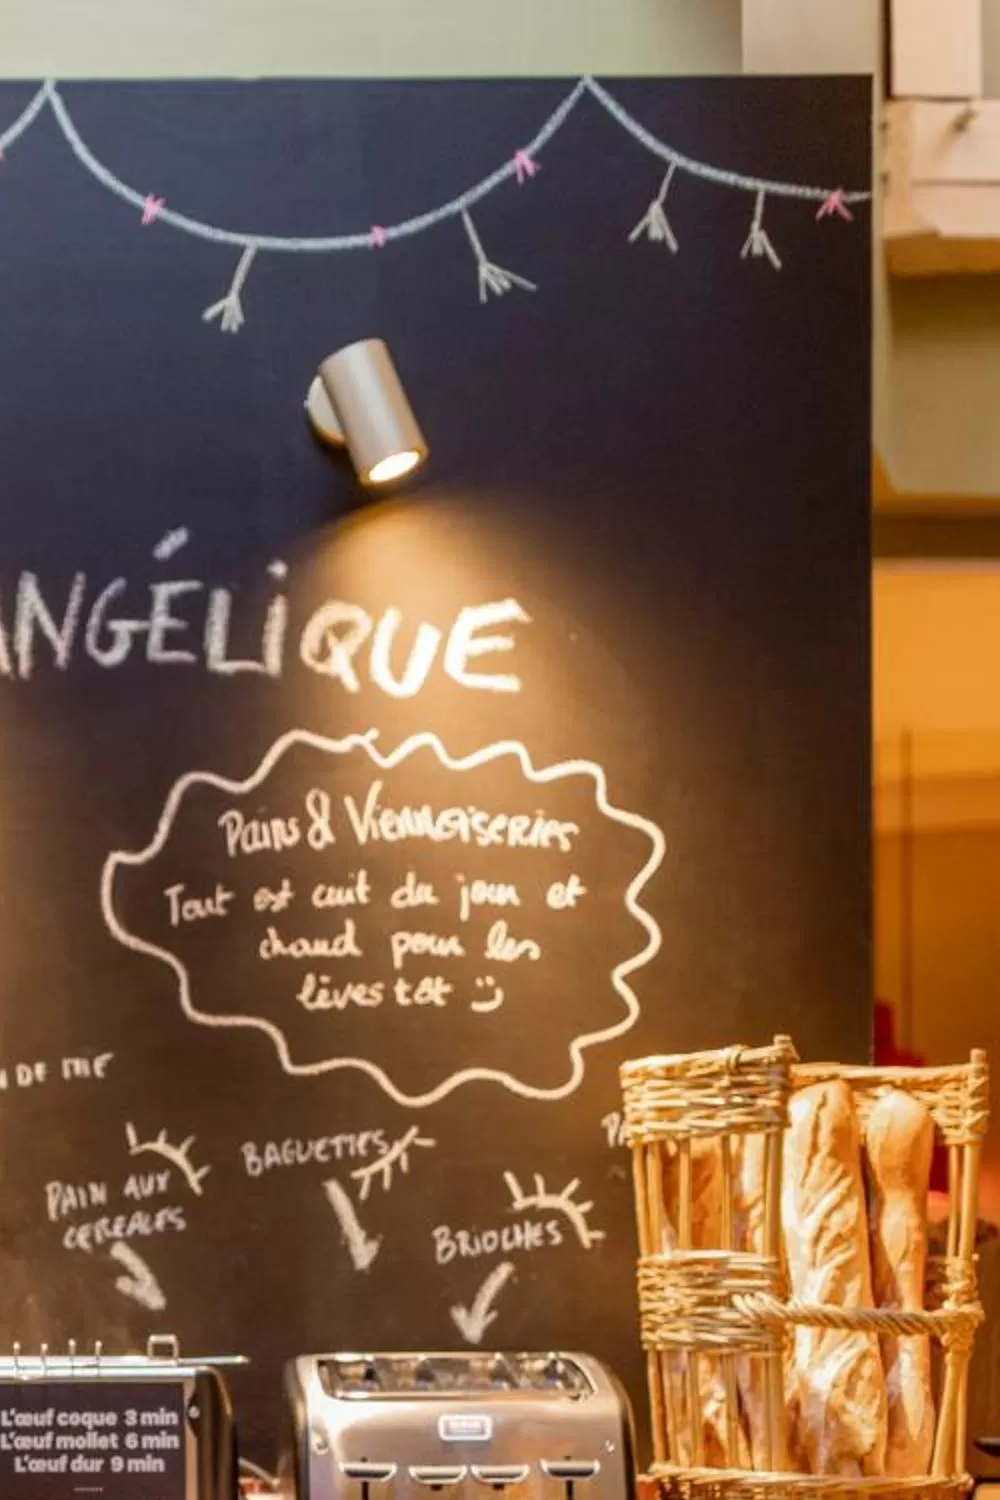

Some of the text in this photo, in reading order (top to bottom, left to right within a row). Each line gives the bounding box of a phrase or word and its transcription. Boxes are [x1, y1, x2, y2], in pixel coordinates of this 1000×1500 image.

[164, 884, 234, 926] Tout
[390, 871, 438, 908] du
[259, 920, 361, 960] chaud
[56, 1413, 118, 1430] coque
[124, 1409, 138, 1426] 3
[140, 1407, 178, 1426] min
[55, 1431, 119, 1449] mollet
[125, 1432, 139, 1449] 6
[141, 1431, 180, 1449] min
[70, 1454, 104, 1473] dur
[110, 1455, 124, 1472] 9
[127, 1454, 165, 1473] min
